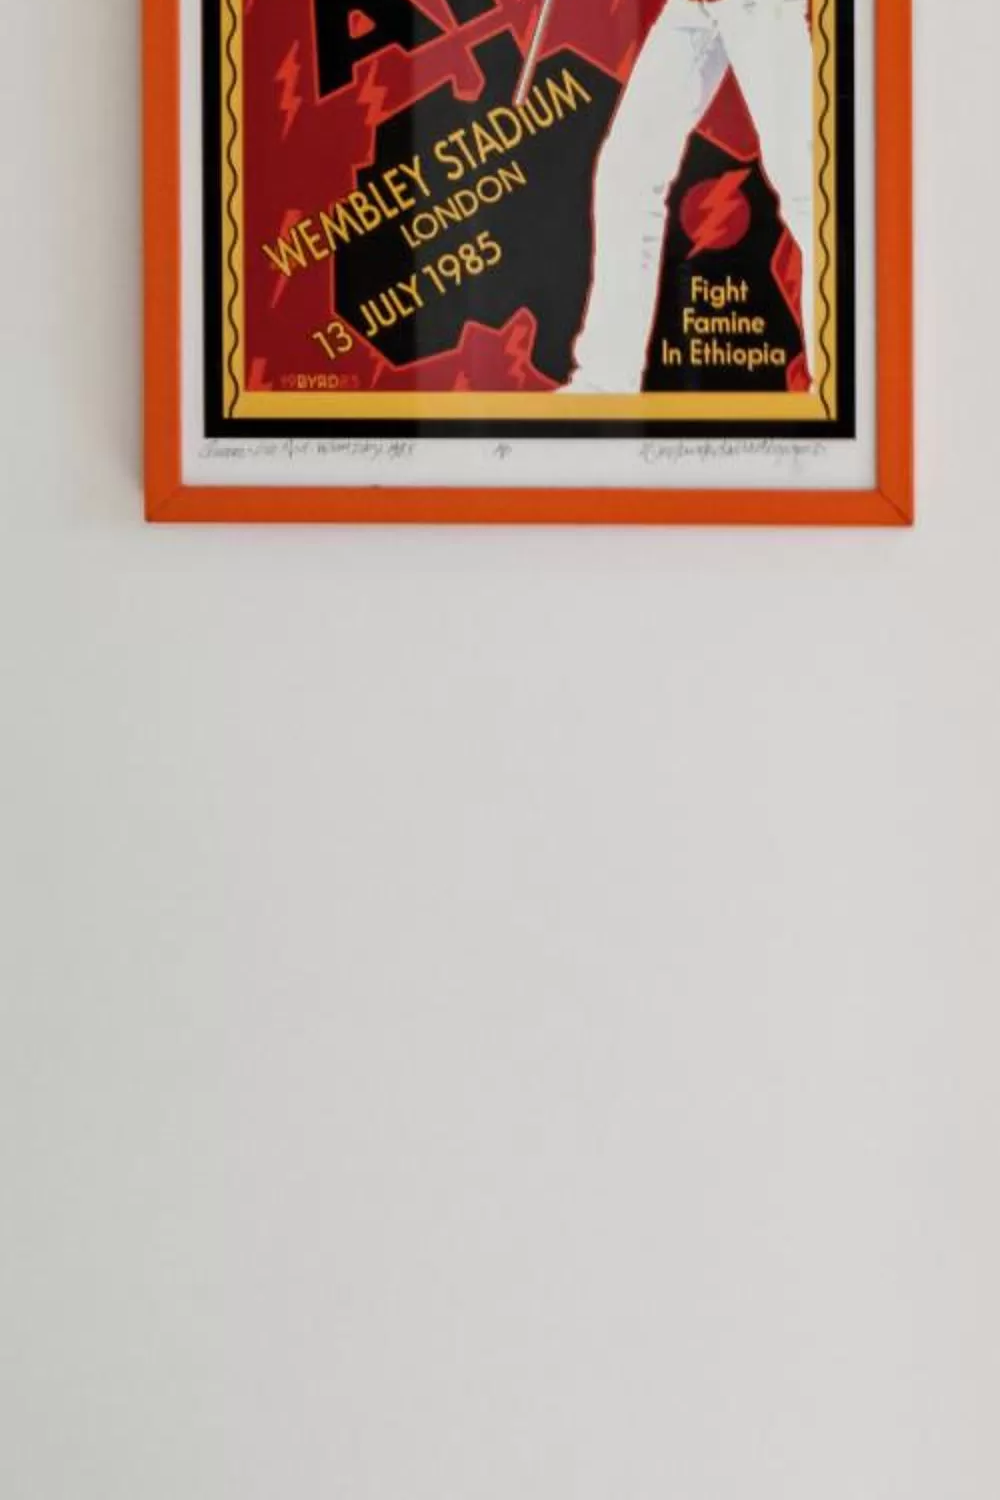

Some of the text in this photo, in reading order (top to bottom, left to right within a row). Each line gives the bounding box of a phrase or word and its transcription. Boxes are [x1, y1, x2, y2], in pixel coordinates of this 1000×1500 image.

[262, 68, 593, 277] WEMBLEY STADIUM
[400, 160, 527, 249] LONDON
[312, 230, 503, 360] 13 JULY 1985
[683, 307, 766, 334] Famine
[691, 276, 748, 308] Fight
[662, 339, 787, 373] In Ethiopia
